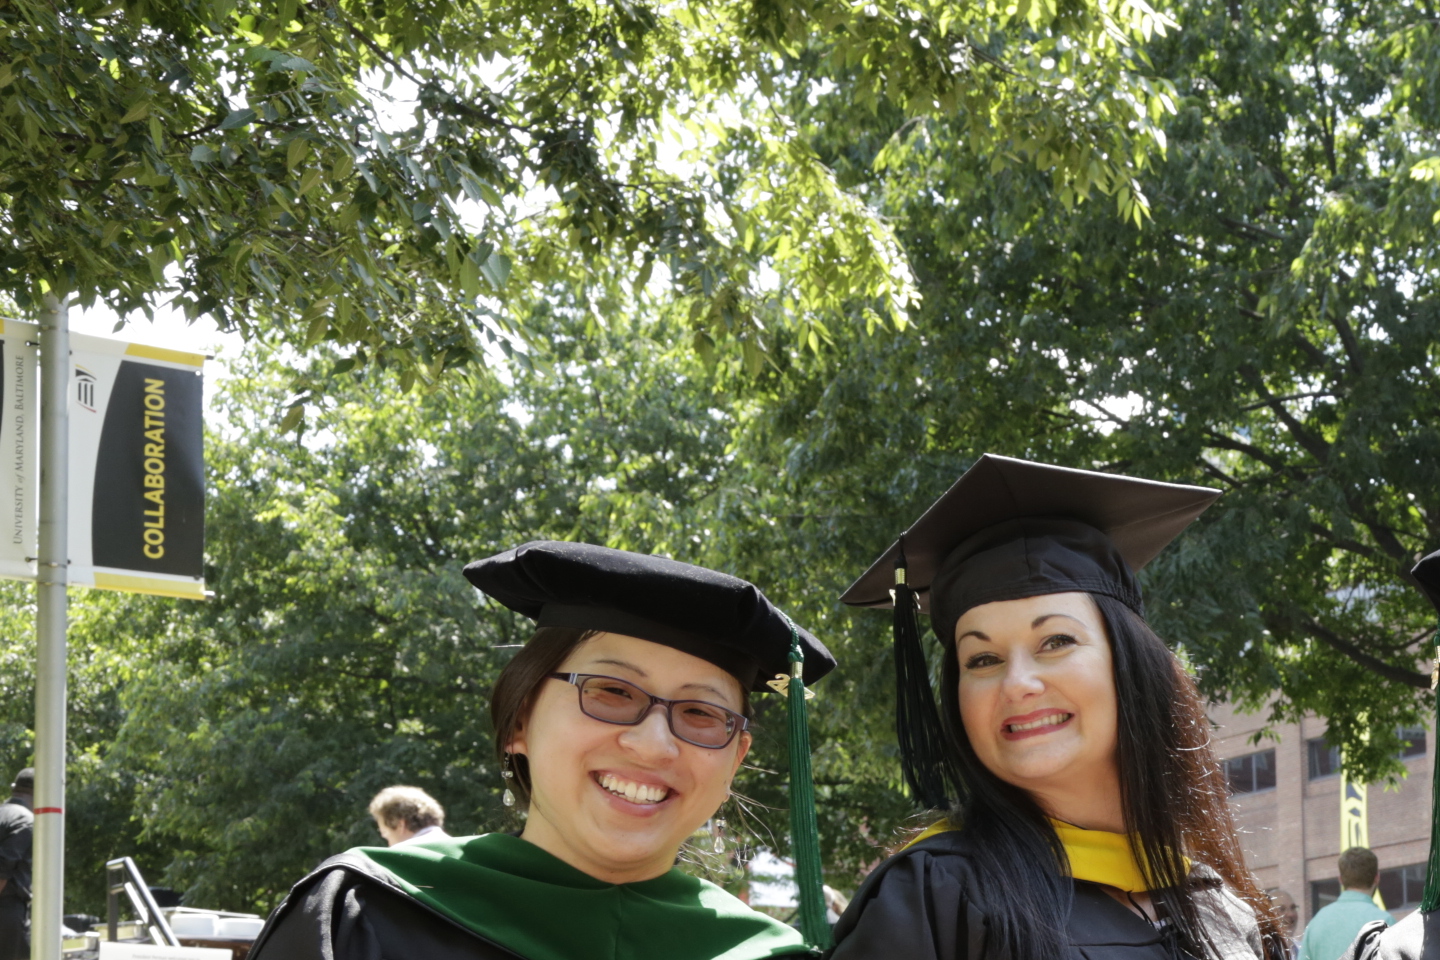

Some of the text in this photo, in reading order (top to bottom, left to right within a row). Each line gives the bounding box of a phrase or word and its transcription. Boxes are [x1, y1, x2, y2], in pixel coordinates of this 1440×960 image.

[14, 354, 24, 411] BALTIMORE
[14, 413, 25, 472] MARYLAND,
[143, 378, 165, 559] COLLABORATION
[17, 473, 25, 485] of
